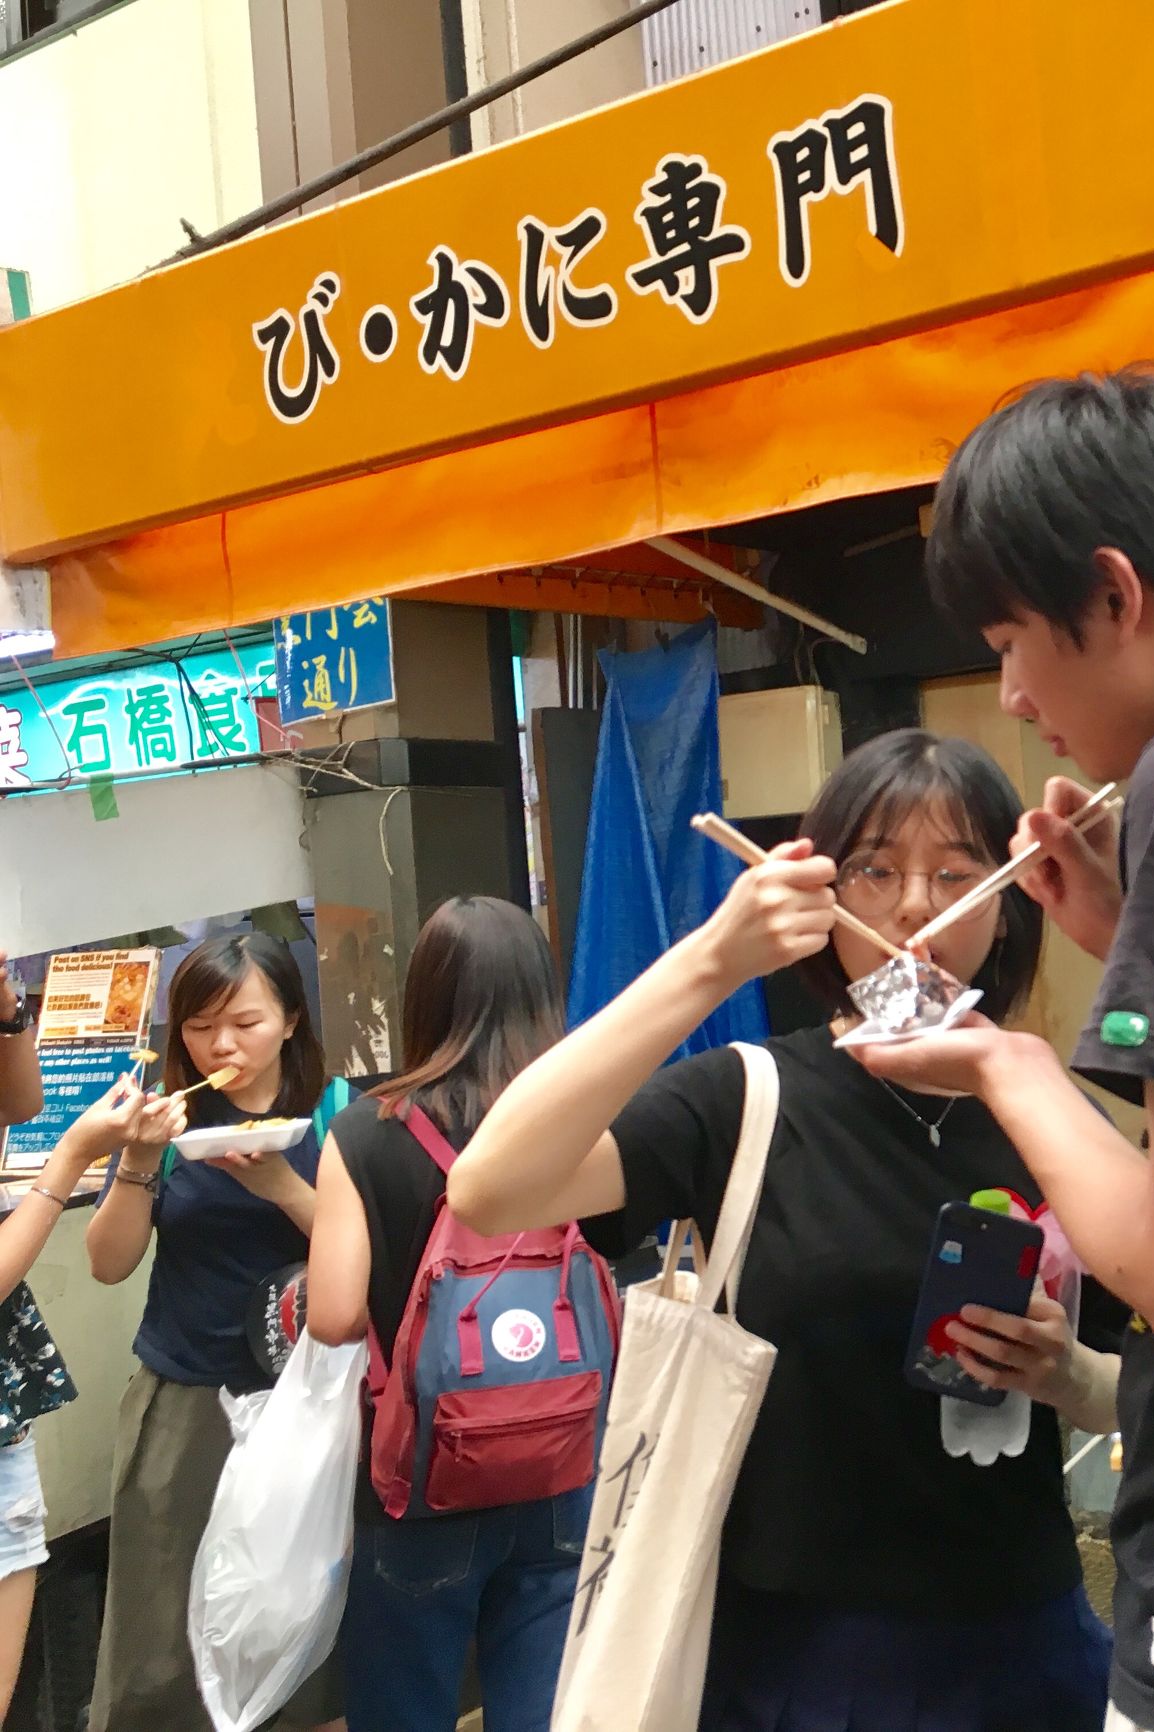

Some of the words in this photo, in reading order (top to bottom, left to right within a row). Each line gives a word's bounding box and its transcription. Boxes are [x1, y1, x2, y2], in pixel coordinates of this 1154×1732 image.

[252, 92, 905, 425] び・かに専門
[302, 645, 358, 711] 通り
[65, 963, 80, 972] food
[80, 952, 95, 962] SNS
